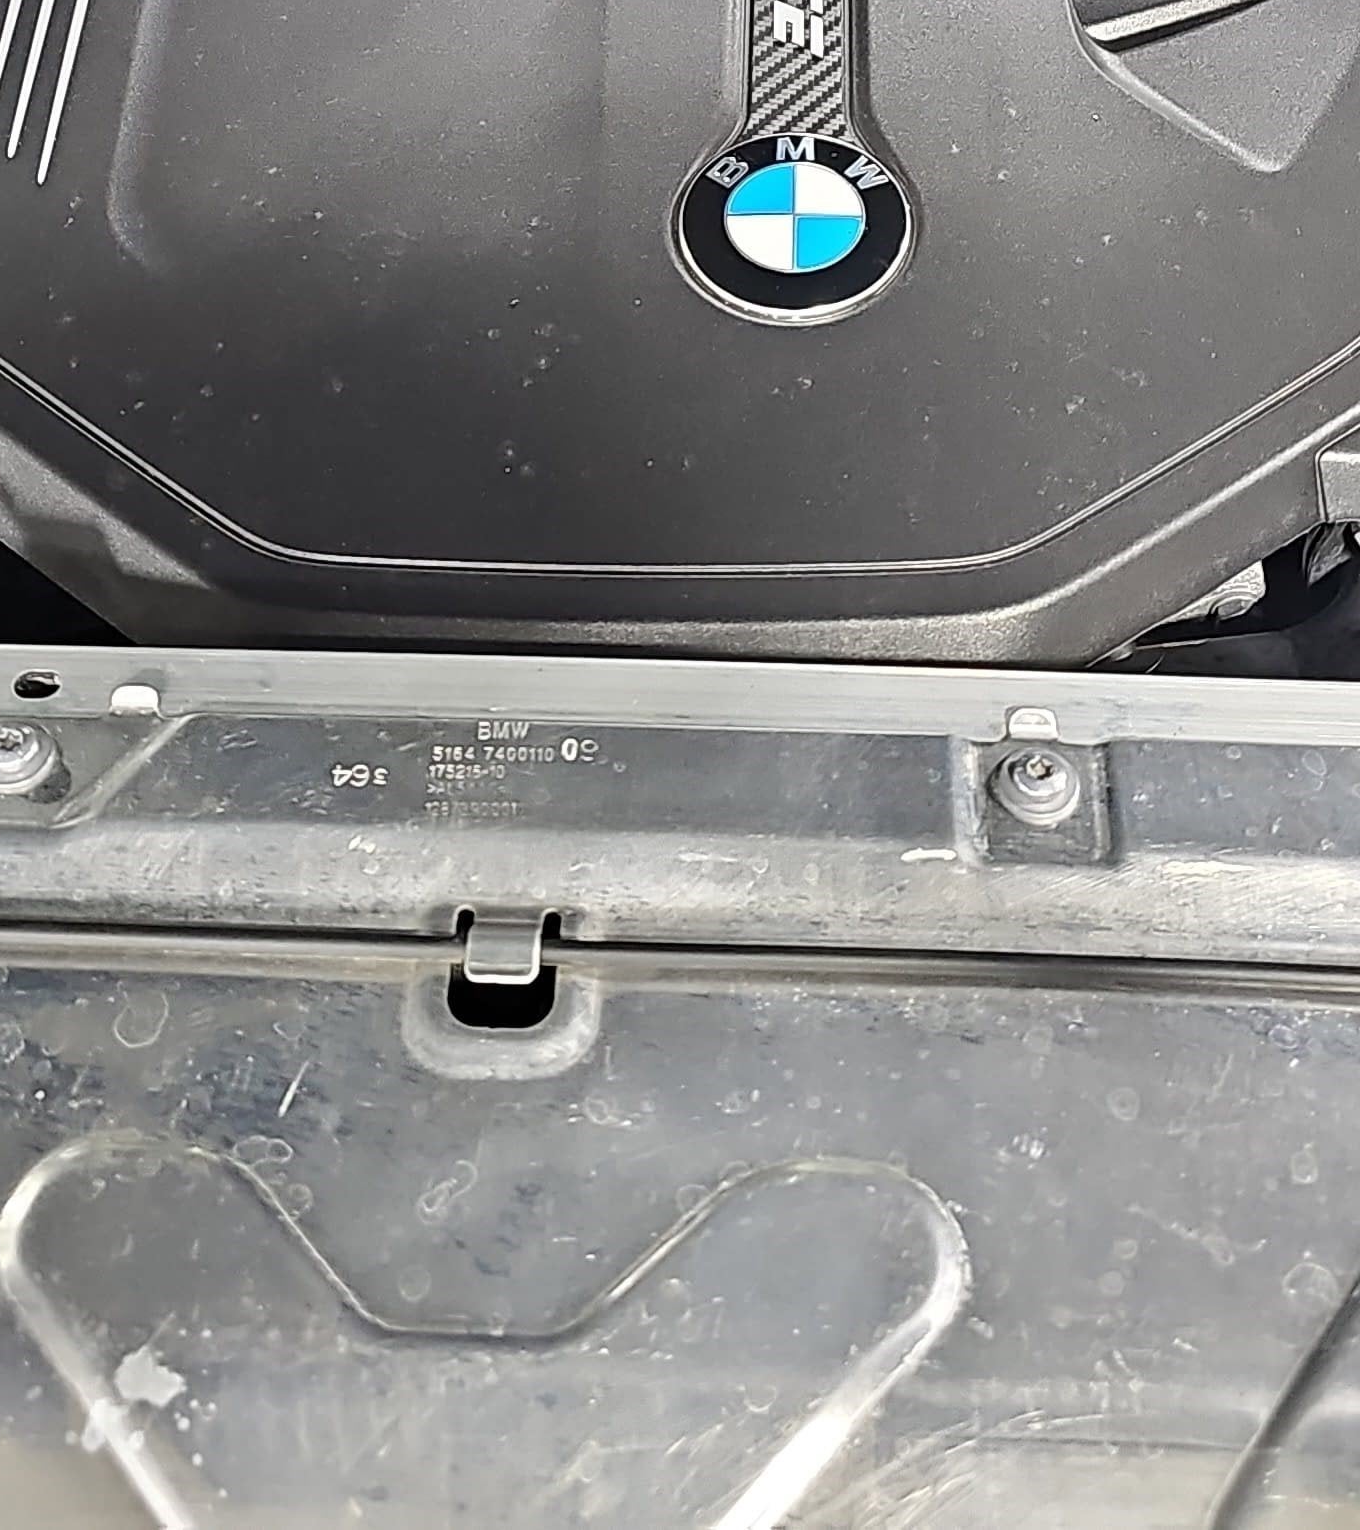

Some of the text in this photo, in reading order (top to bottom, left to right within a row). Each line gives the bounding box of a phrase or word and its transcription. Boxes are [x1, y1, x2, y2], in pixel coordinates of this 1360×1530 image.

[705, 136, 890, 190] BMW
[477, 720, 530, 741] BMW
[430, 745, 476, 762] 5164
